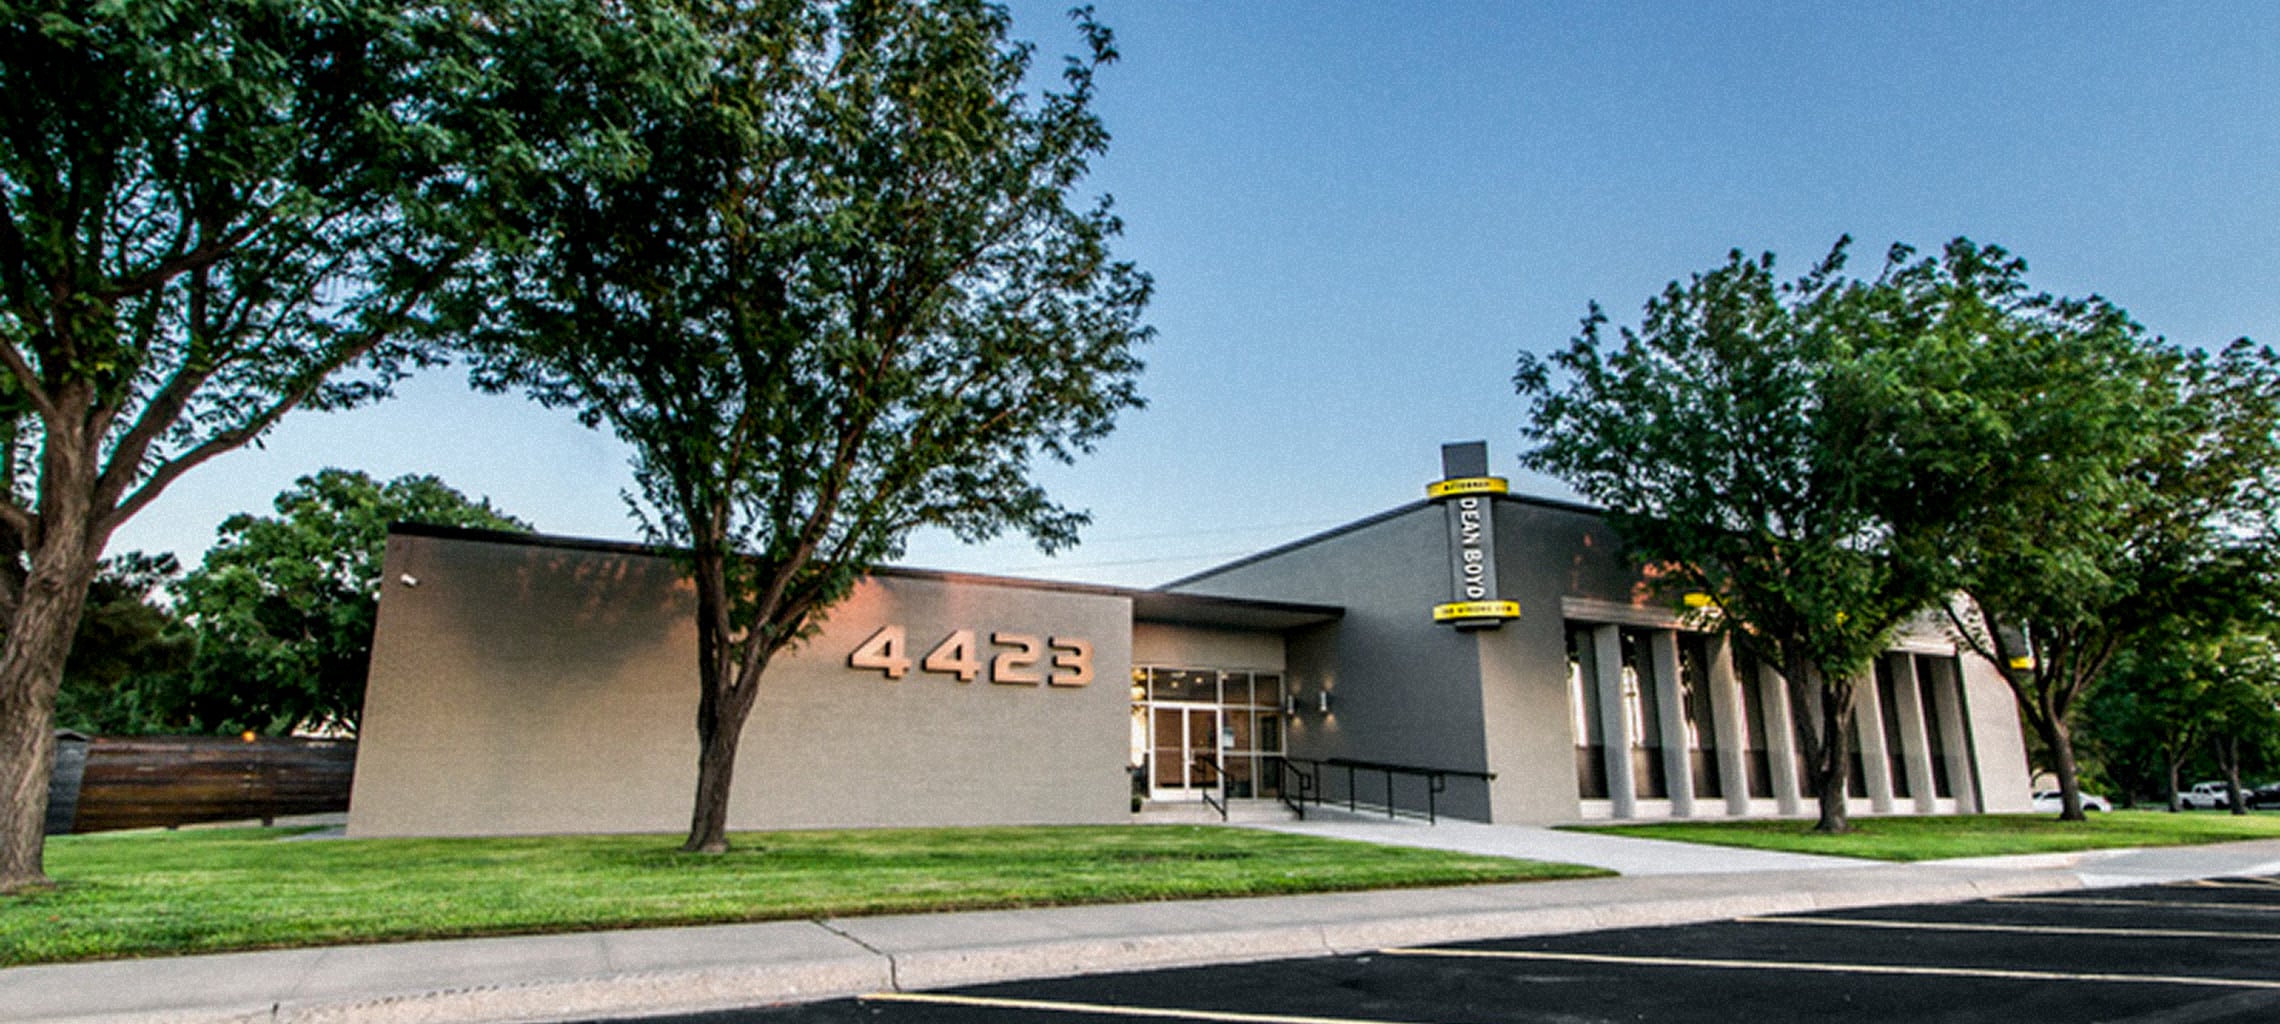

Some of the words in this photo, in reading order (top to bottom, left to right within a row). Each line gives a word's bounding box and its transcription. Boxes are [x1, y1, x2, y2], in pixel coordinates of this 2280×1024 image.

[1460, 497, 1481, 545] DEAN
[1464, 549, 1485, 598] BOYD
[848, 624, 1094, 687] 4423
